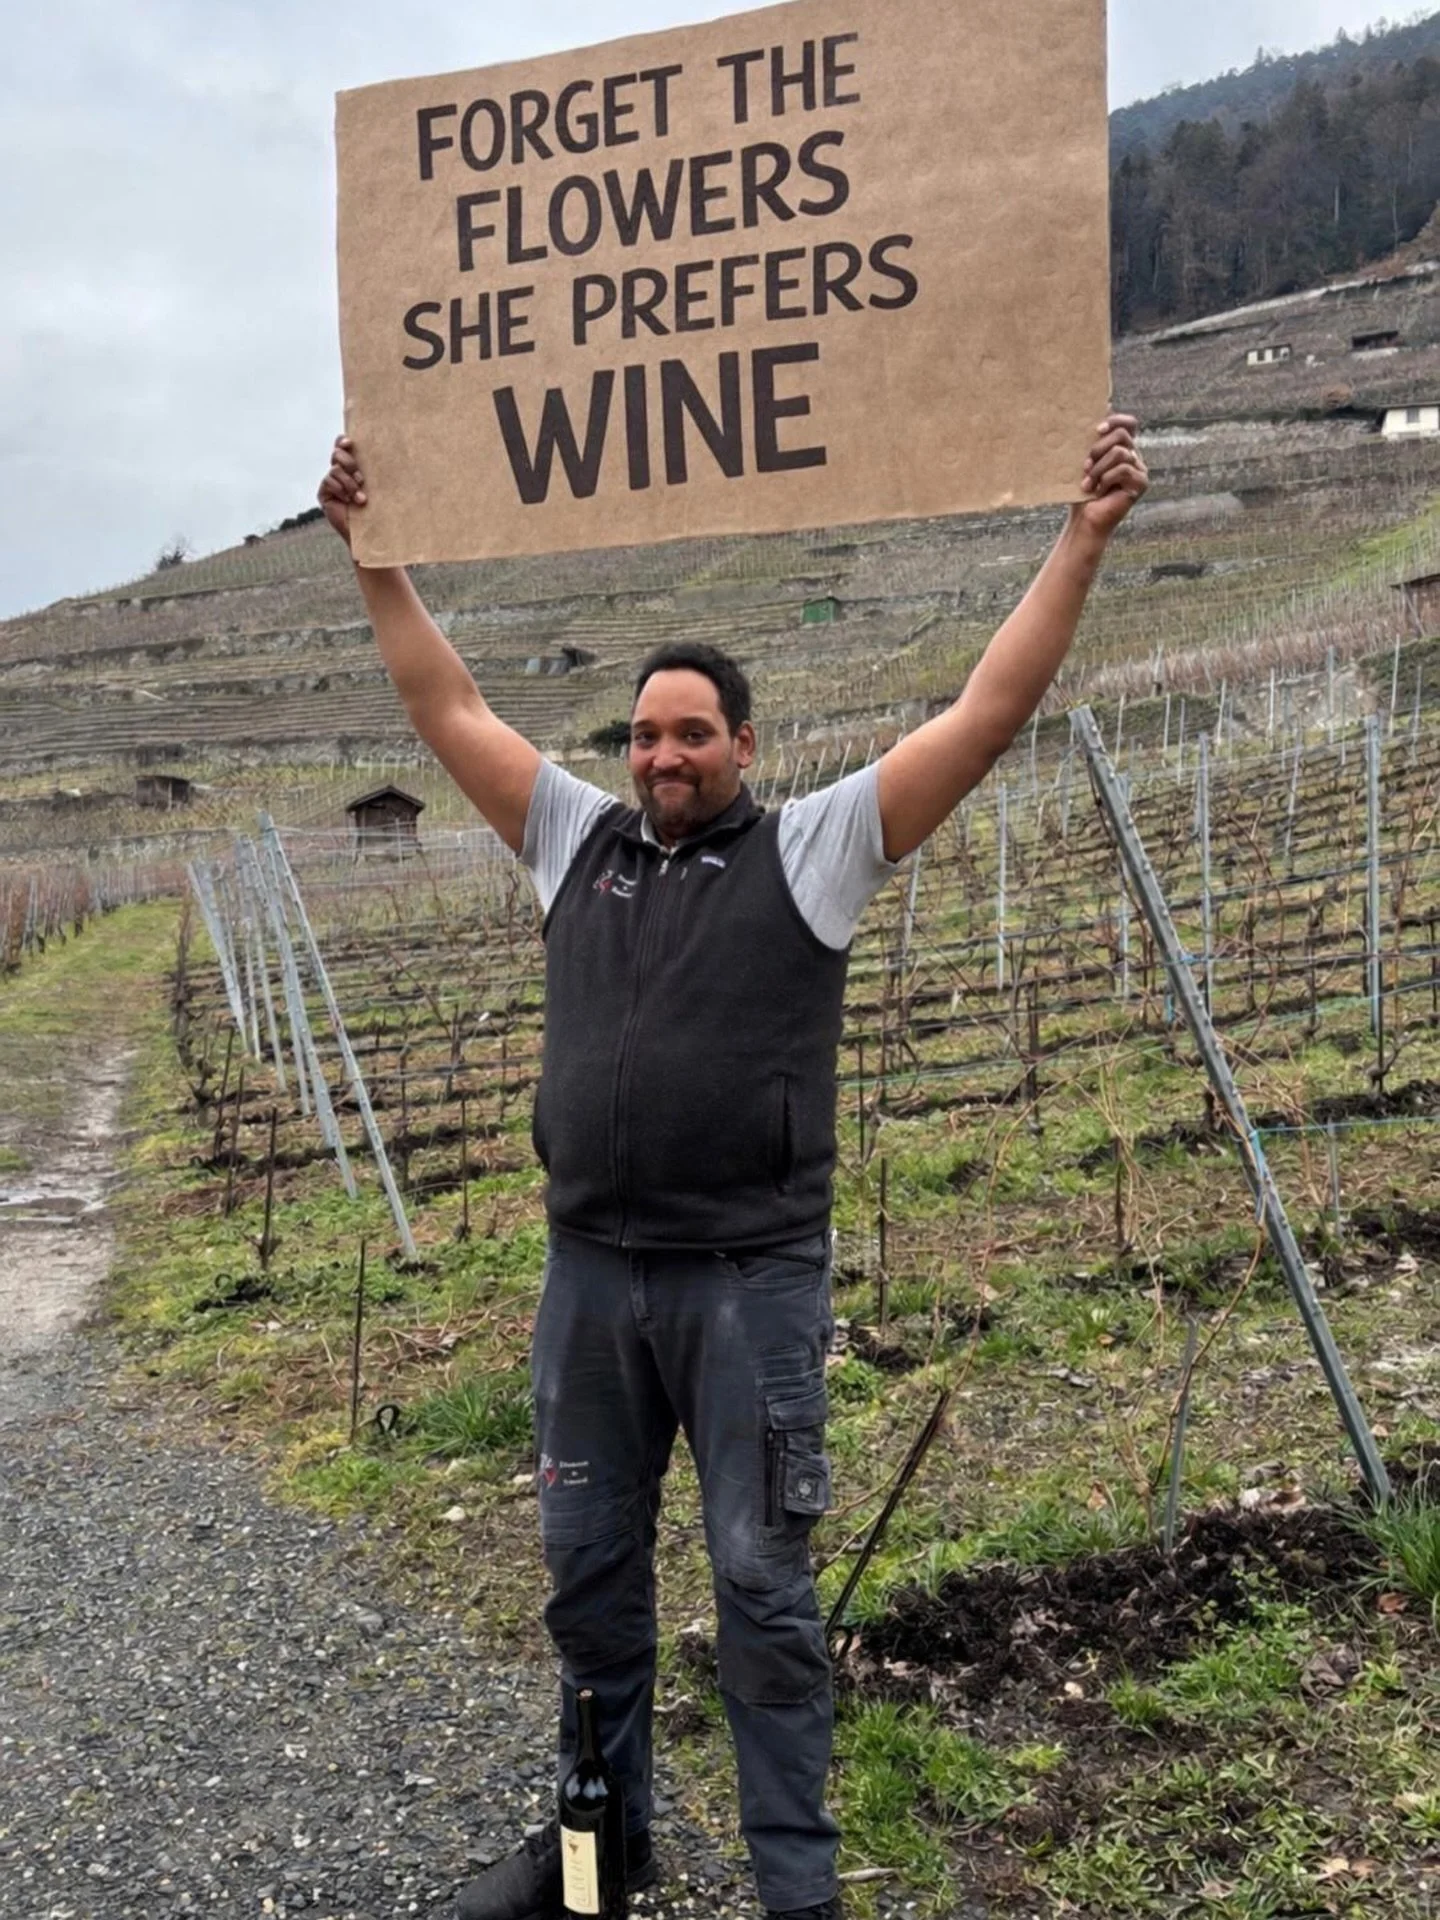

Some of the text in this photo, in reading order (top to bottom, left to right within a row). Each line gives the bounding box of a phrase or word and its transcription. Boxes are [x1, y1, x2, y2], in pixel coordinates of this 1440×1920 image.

[416, 33, 860, 181] FORGET THE
[456, 130, 849, 273] FLOWERS
[402, 234, 918, 371] SHE PREFERS
[492, 342, 827, 505] WINE
